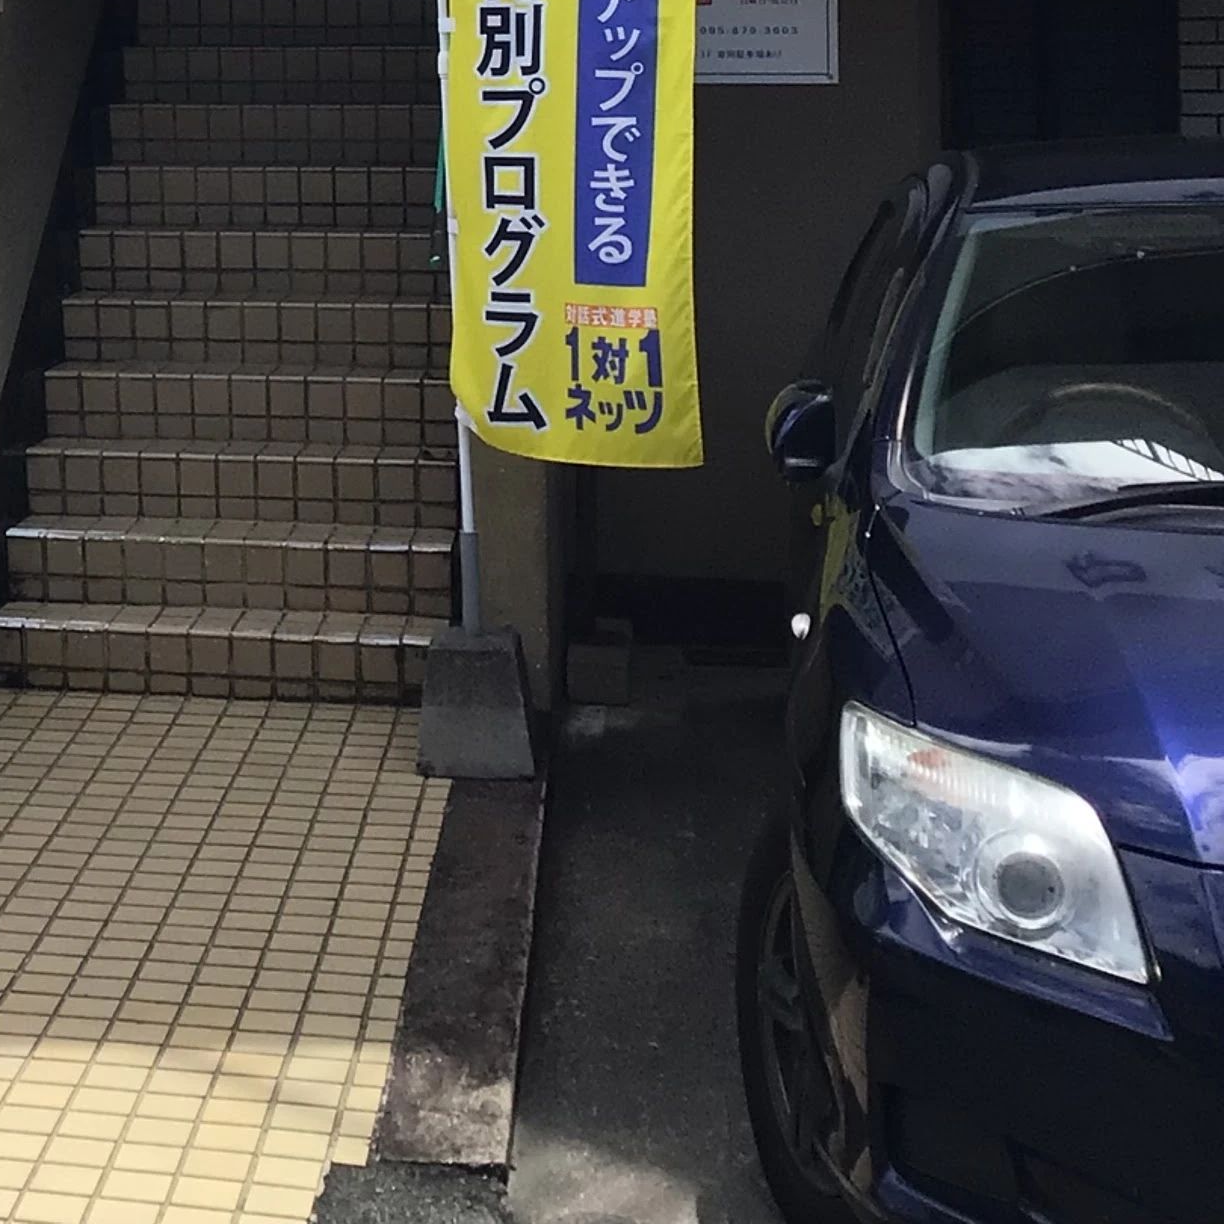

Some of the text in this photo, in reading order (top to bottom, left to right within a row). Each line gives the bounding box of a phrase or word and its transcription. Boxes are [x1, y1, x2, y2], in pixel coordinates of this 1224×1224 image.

[565, 326, 663, 388] 1対1
[565, 383, 663, 434] ネッツ
